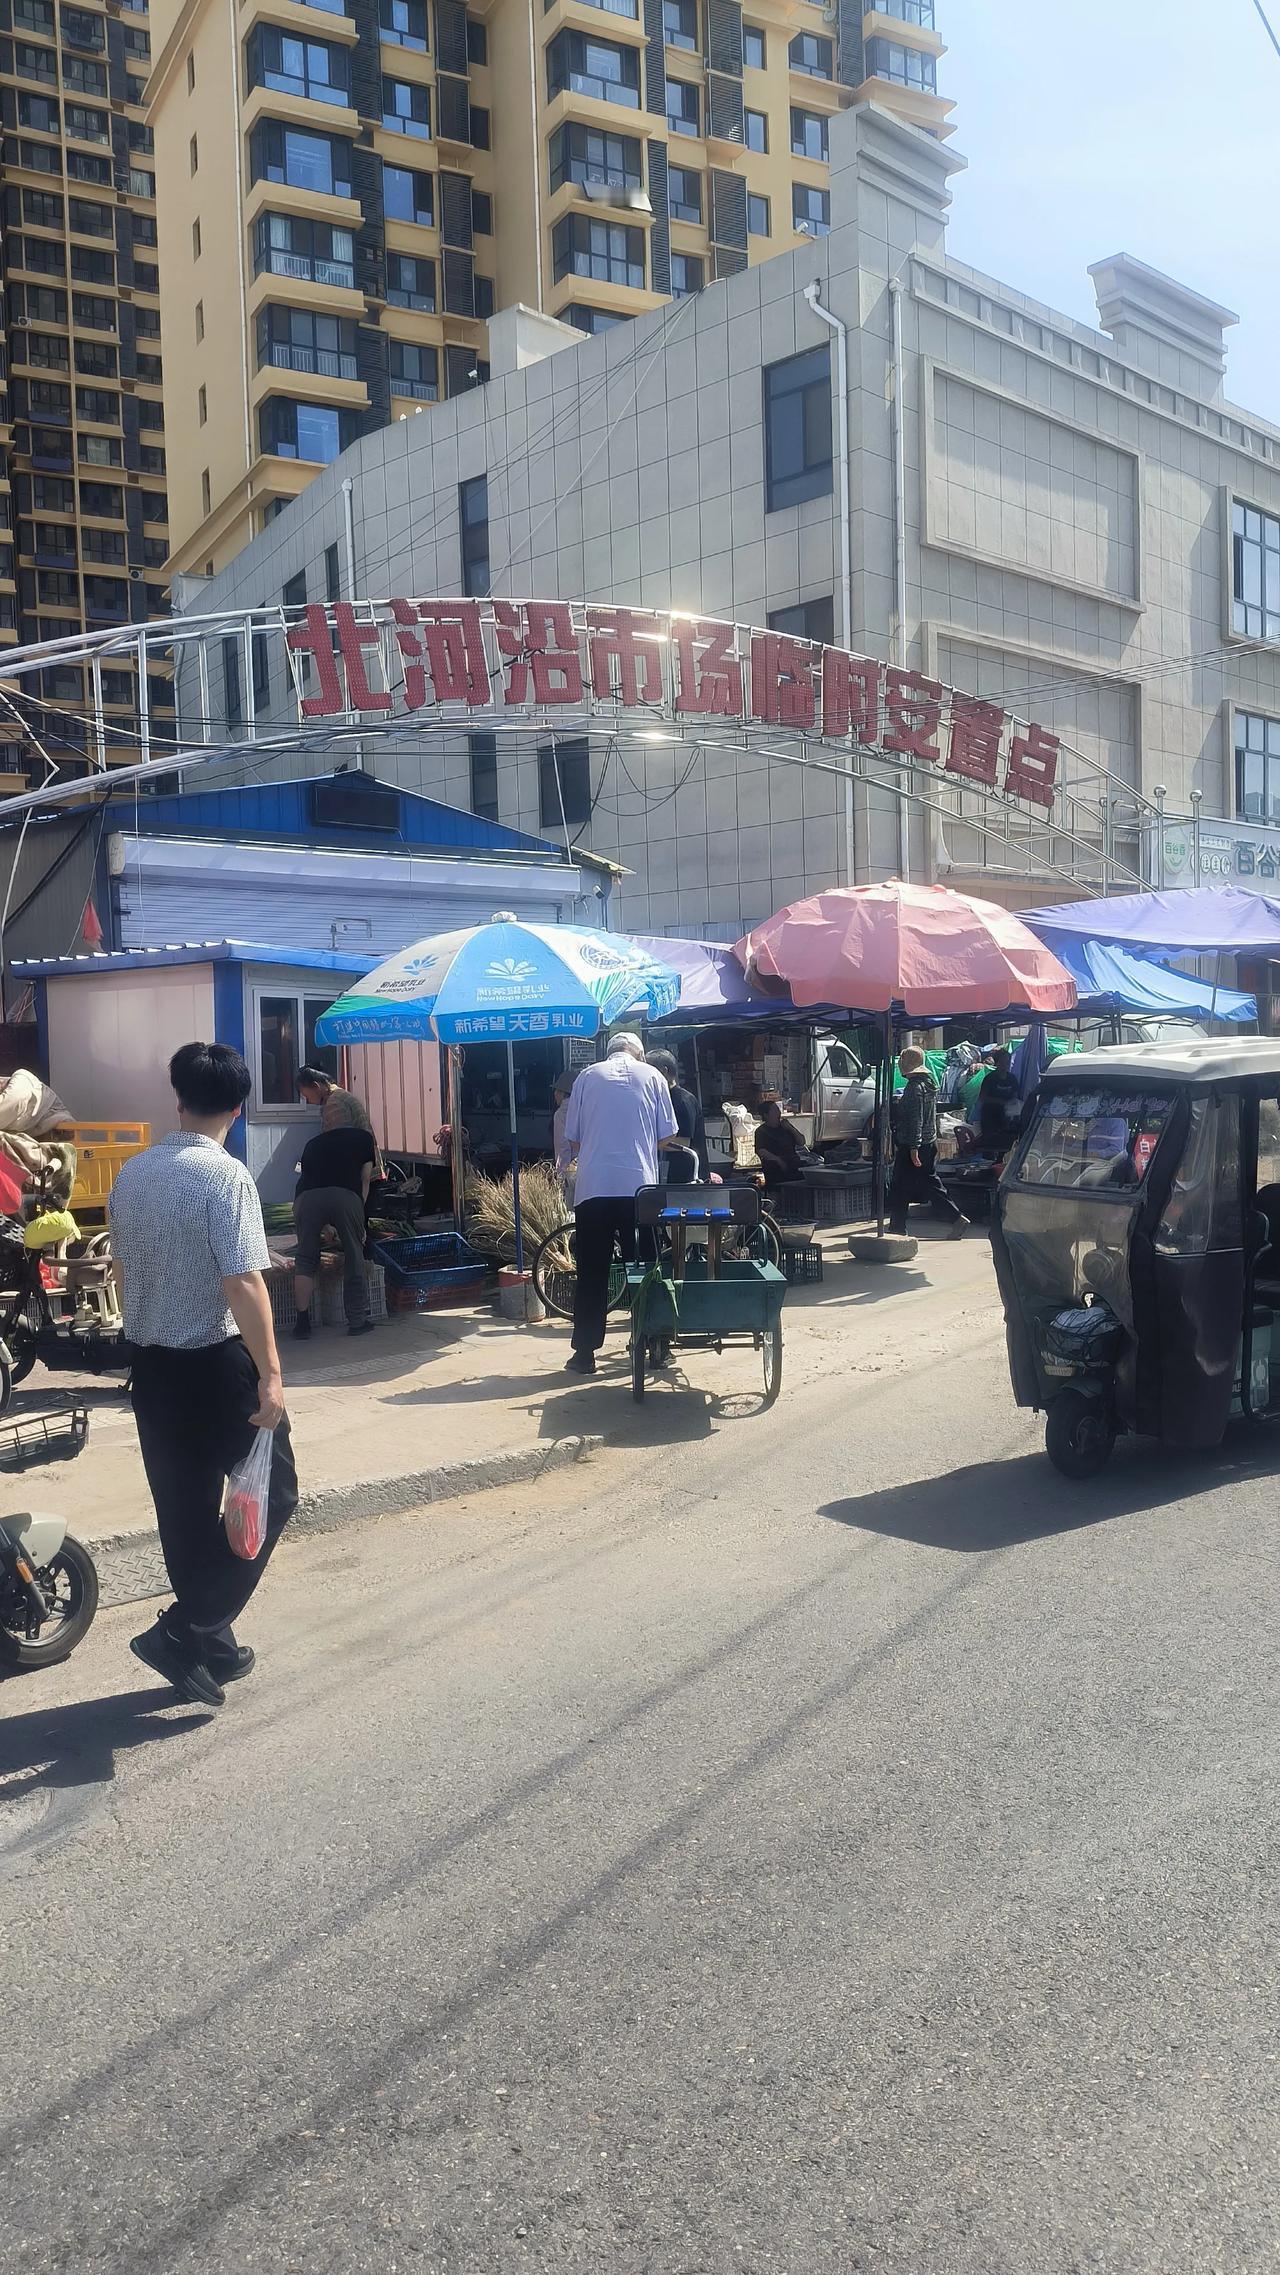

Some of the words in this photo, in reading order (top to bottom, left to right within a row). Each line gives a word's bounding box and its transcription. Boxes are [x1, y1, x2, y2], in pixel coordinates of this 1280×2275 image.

[286, 598, 1059, 808] 北河沿市场临时安置点
[1234, 840, 1280, 878] 百谷
